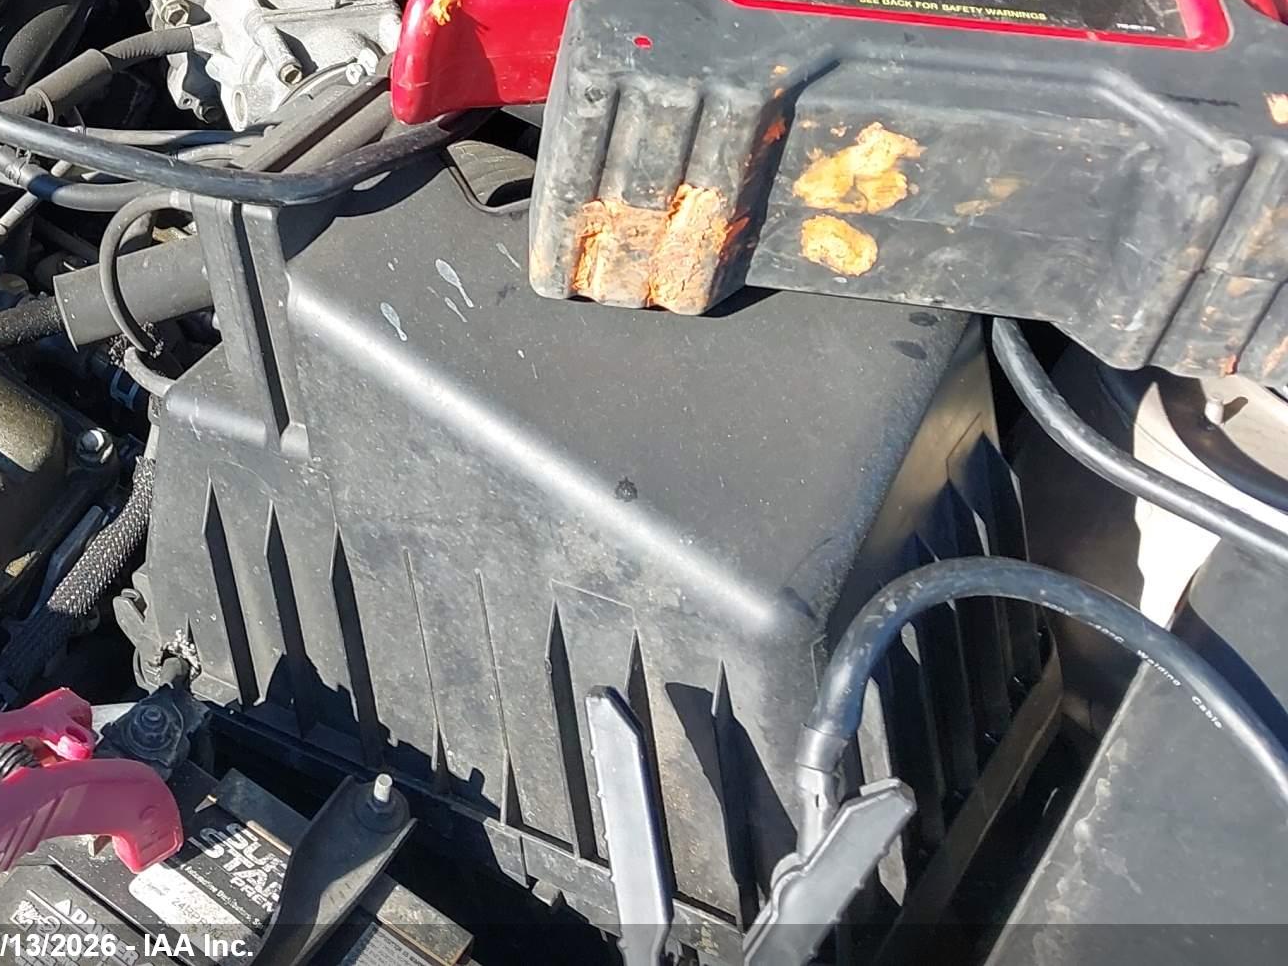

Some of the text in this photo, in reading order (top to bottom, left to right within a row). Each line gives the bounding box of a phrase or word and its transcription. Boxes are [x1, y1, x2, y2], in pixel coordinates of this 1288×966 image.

[914, 0, 940, 11] FOR
[941, 2, 983, 15] SAFETY
[984, 6, 1048, 21] WARNINGS
[1136, 649, 1181, 687] Welding
[1191, 695, 1223, 729] Cable
[219, 823, 289, 879] SUP
